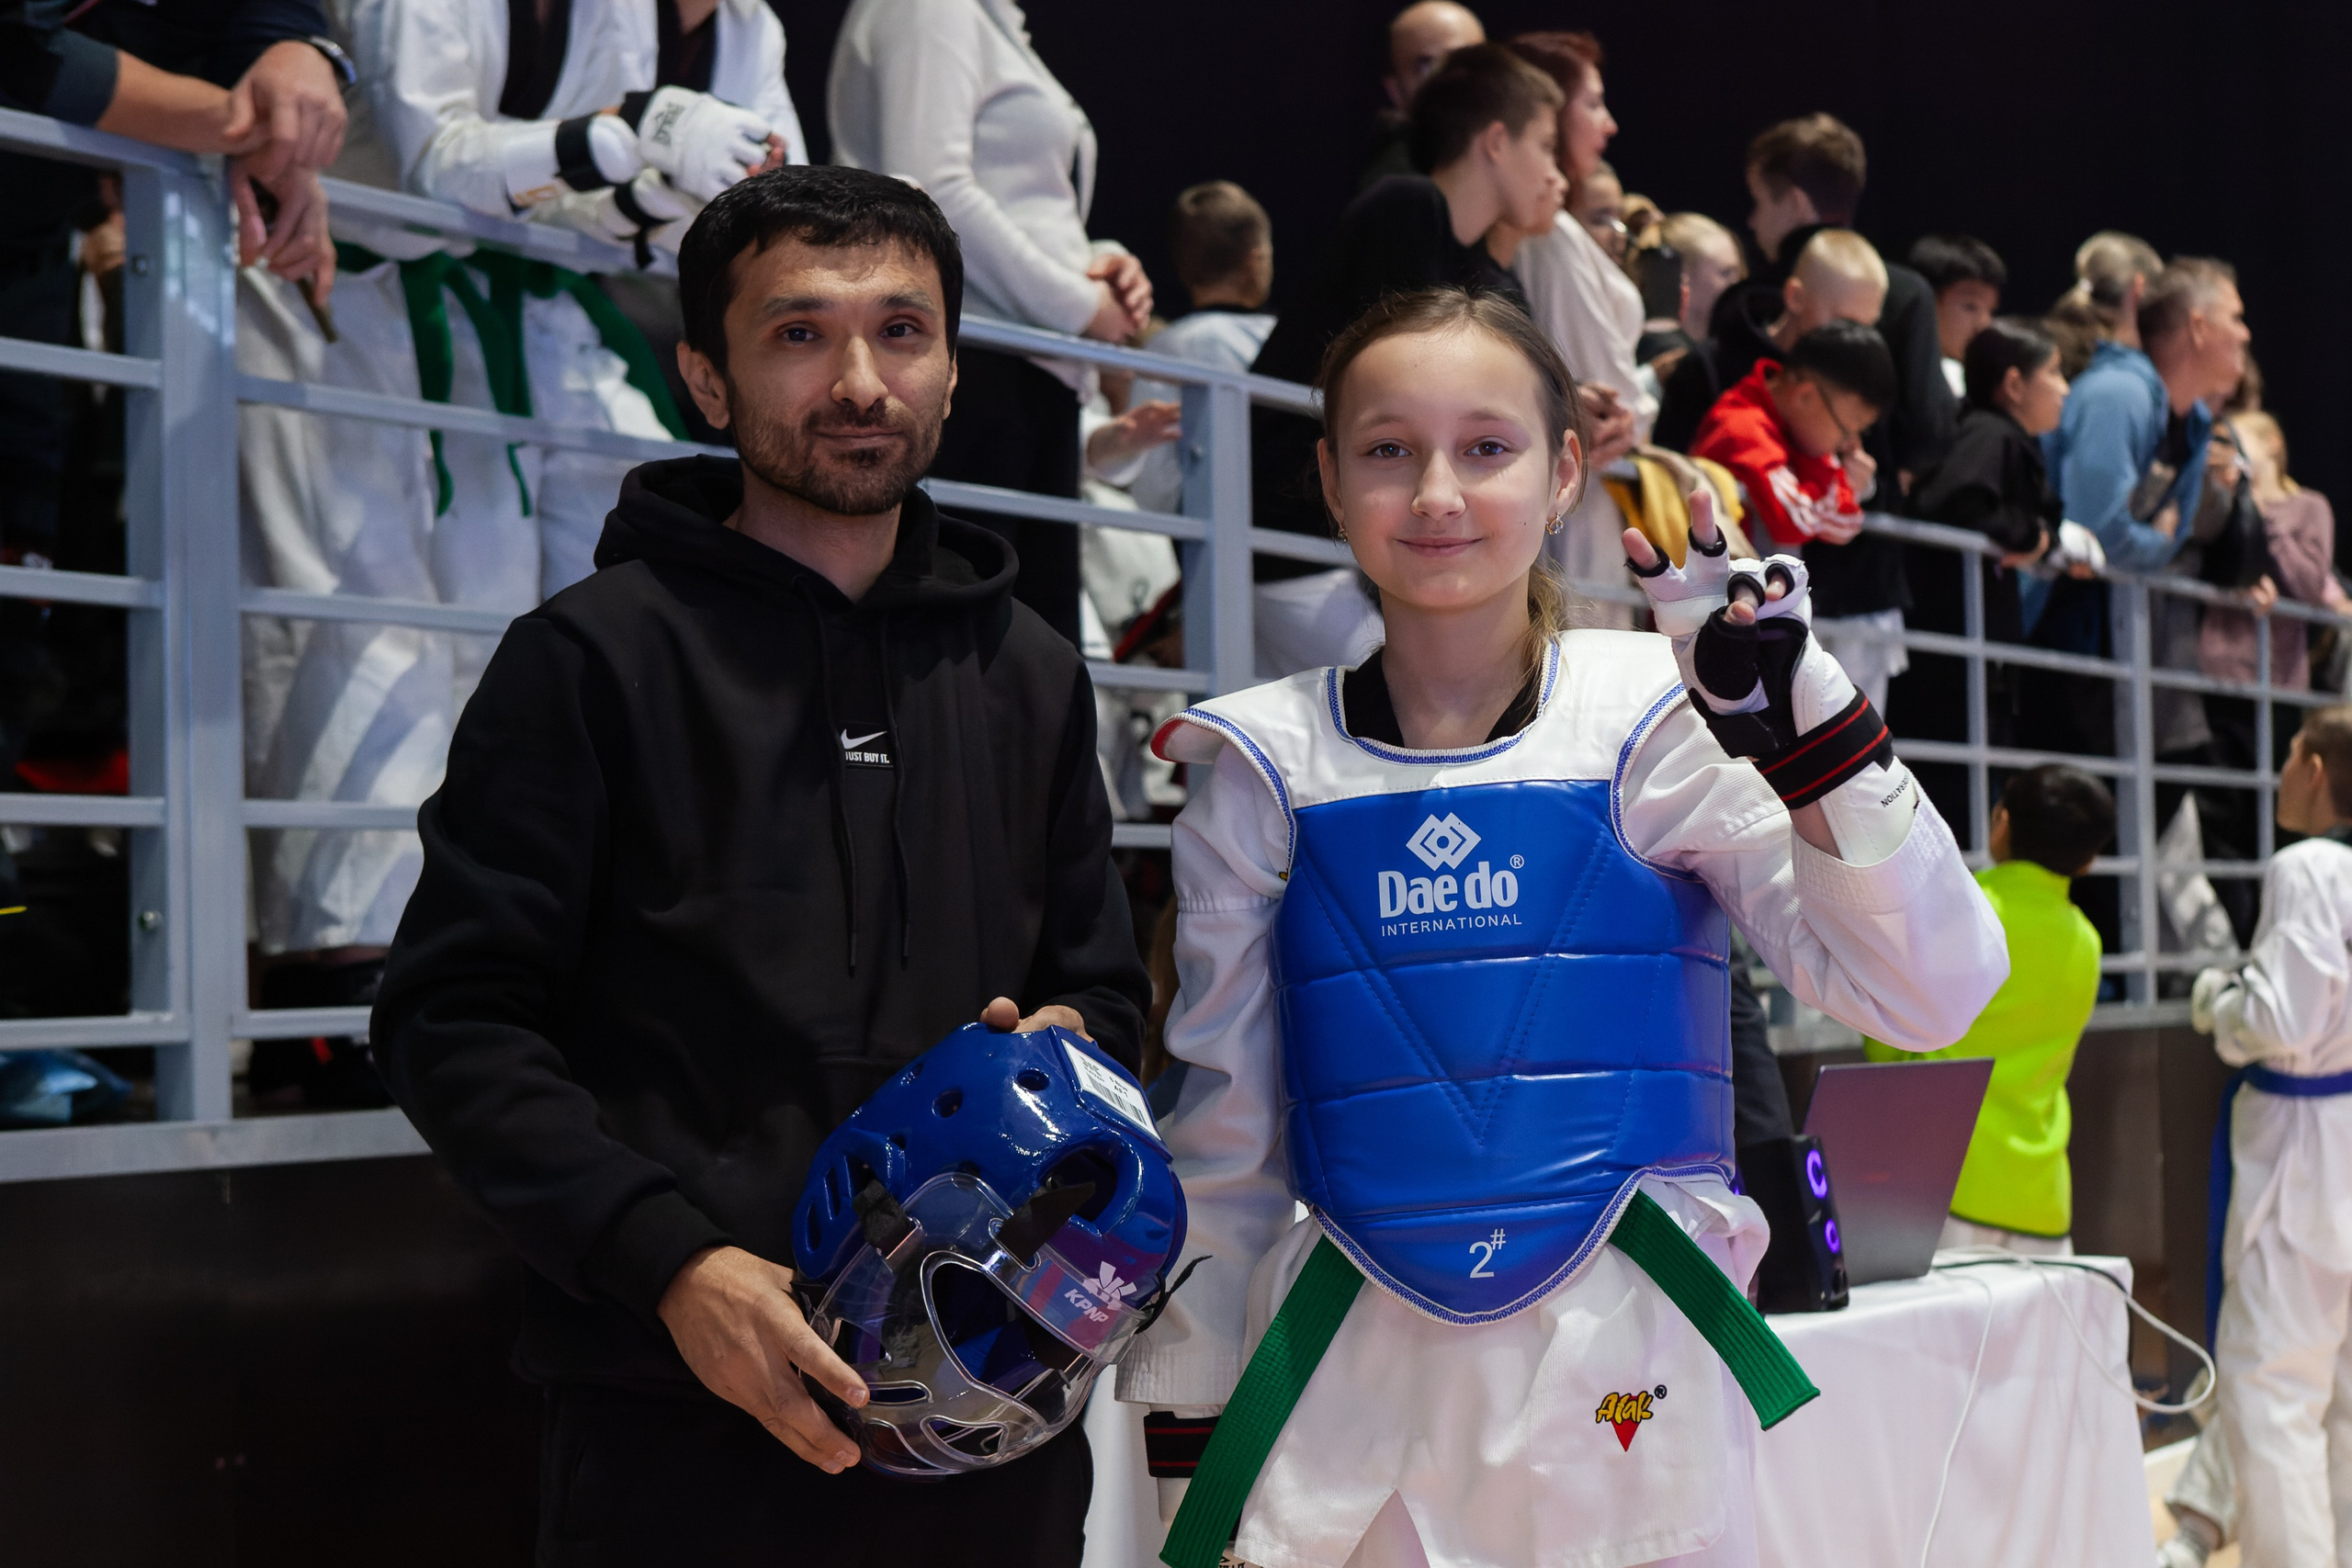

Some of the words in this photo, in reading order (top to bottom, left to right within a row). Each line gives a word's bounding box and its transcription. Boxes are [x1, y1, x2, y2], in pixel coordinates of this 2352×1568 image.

[864, 752, 879, 763] BUY
[879, 753, 890, 763] IT.
[1381, 913, 1522, 937] INTERNATIONAL
[1064, 1288, 1110, 1323] KPNP
